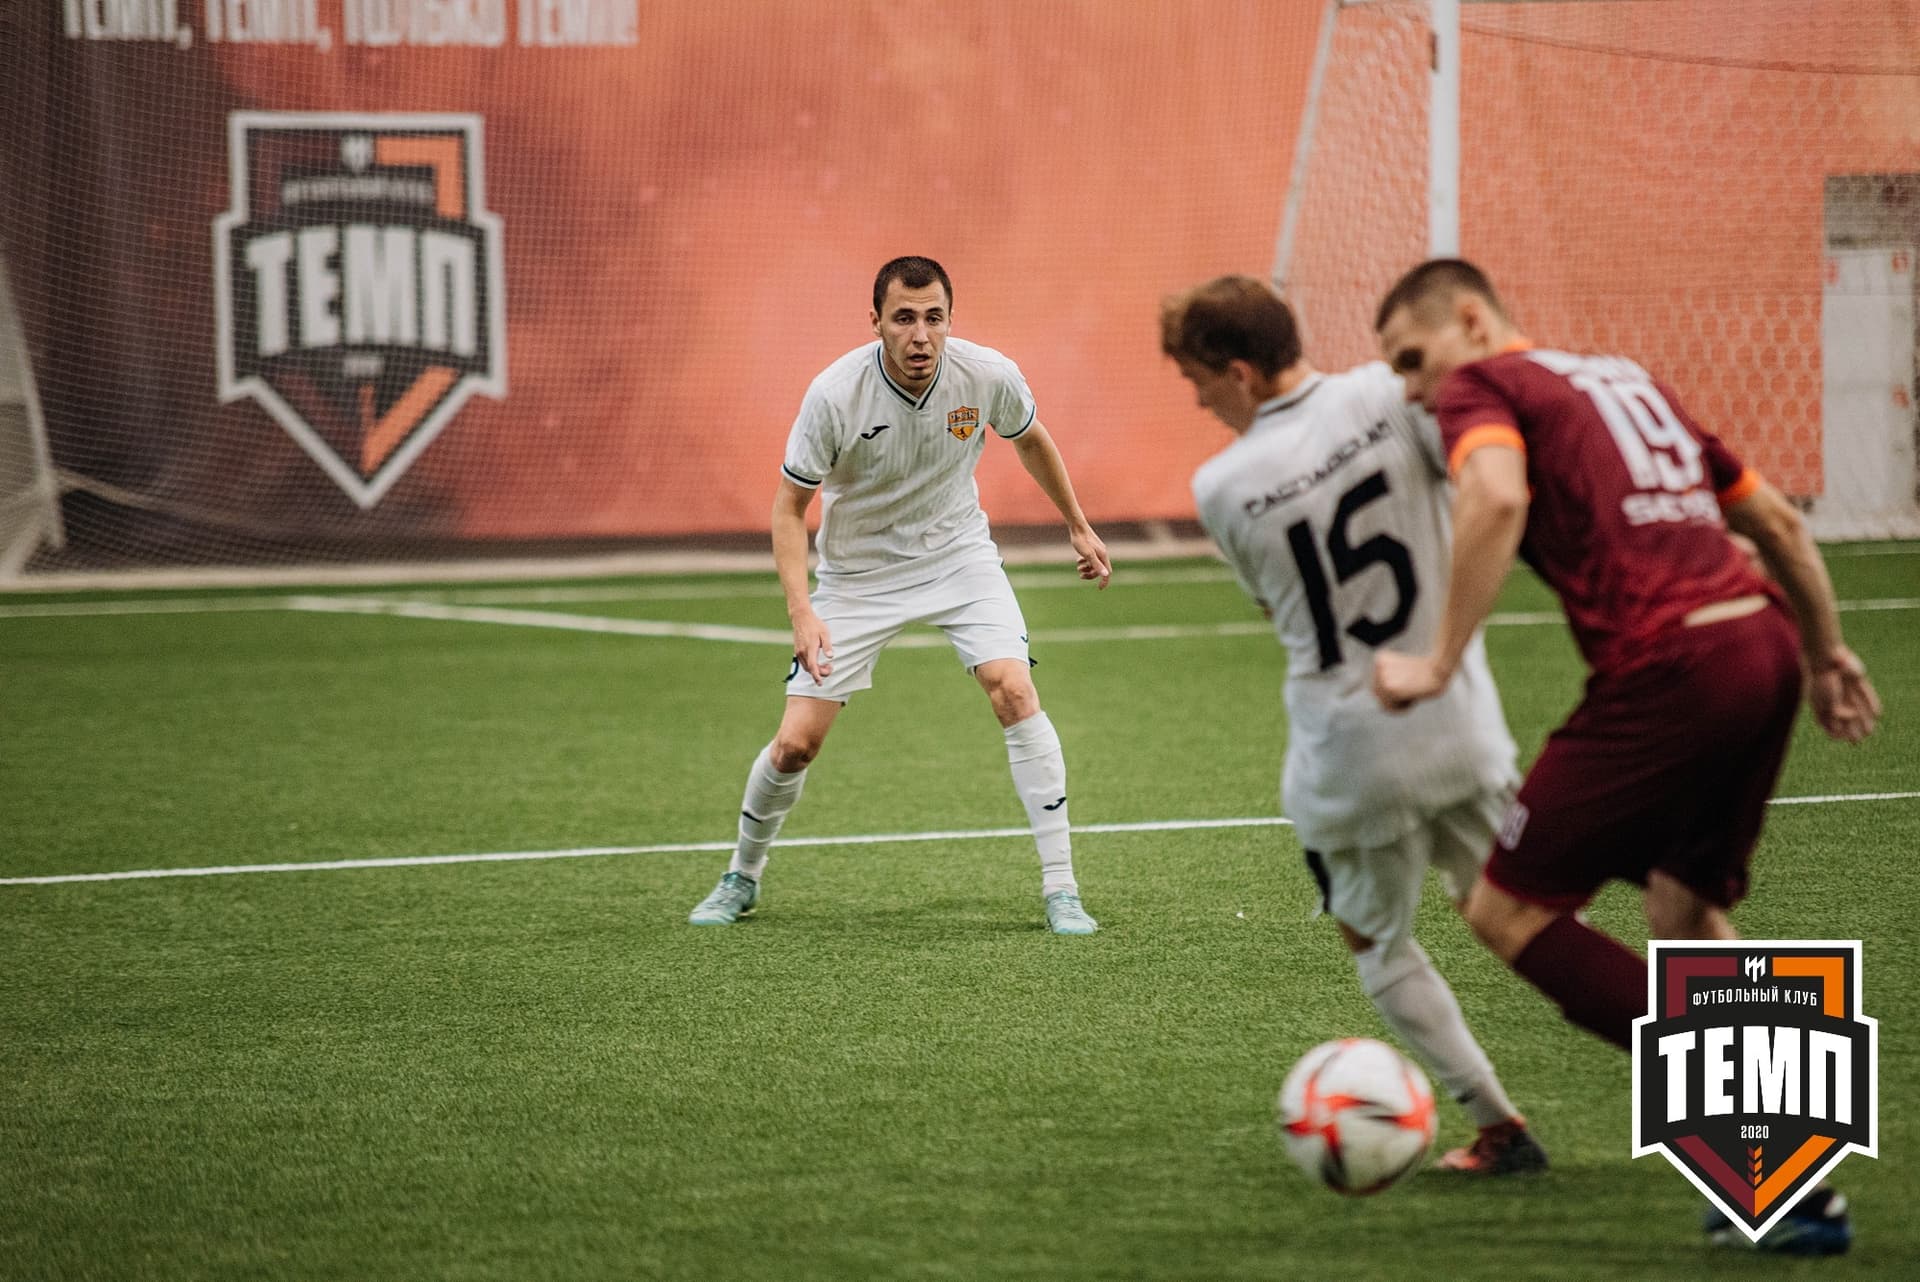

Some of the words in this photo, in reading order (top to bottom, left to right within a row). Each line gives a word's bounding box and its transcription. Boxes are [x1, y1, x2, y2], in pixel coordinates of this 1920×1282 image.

[246, 224, 476, 357] ТЕМП
[1568, 373, 1704, 493] 19
[1287, 468, 1419, 672] 15
